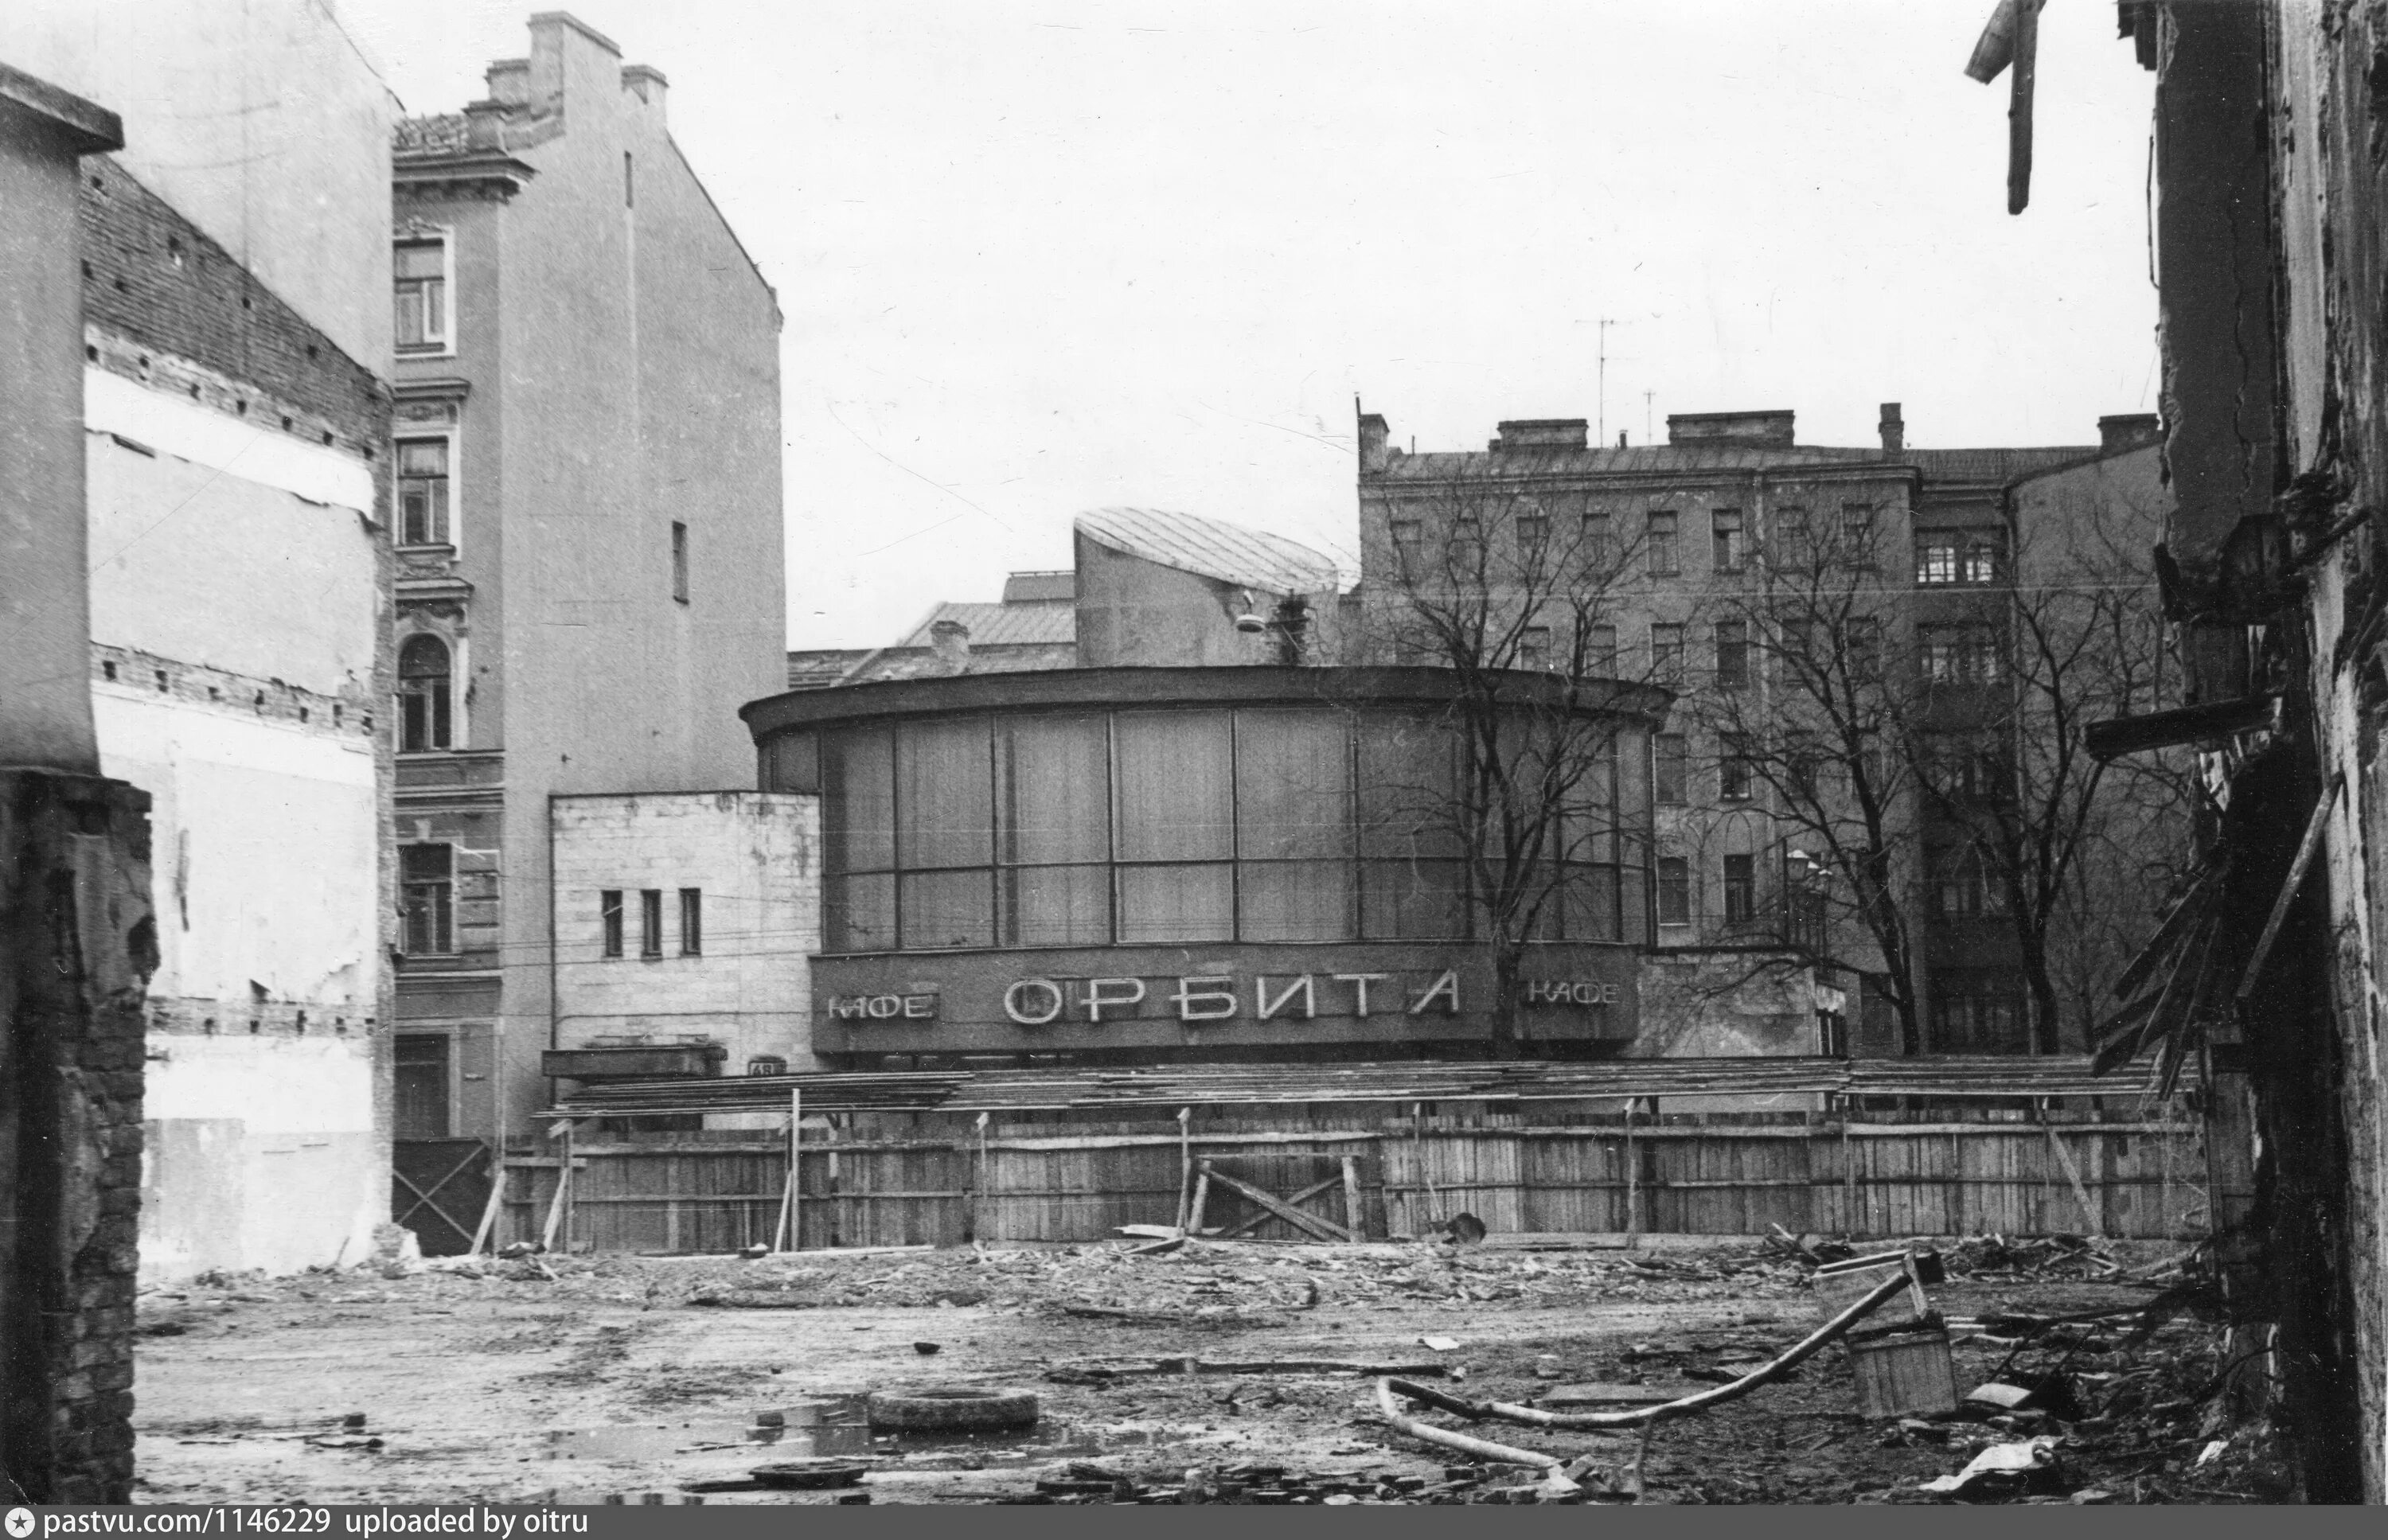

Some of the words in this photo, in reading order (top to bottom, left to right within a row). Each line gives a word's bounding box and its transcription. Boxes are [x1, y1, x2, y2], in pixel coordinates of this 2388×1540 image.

[1004, 970, 1458, 1023] ОРБИТА
[1529, 979, 1619, 1004] КАФЕ
[828, 996, 933, 1019] КАФЕ
